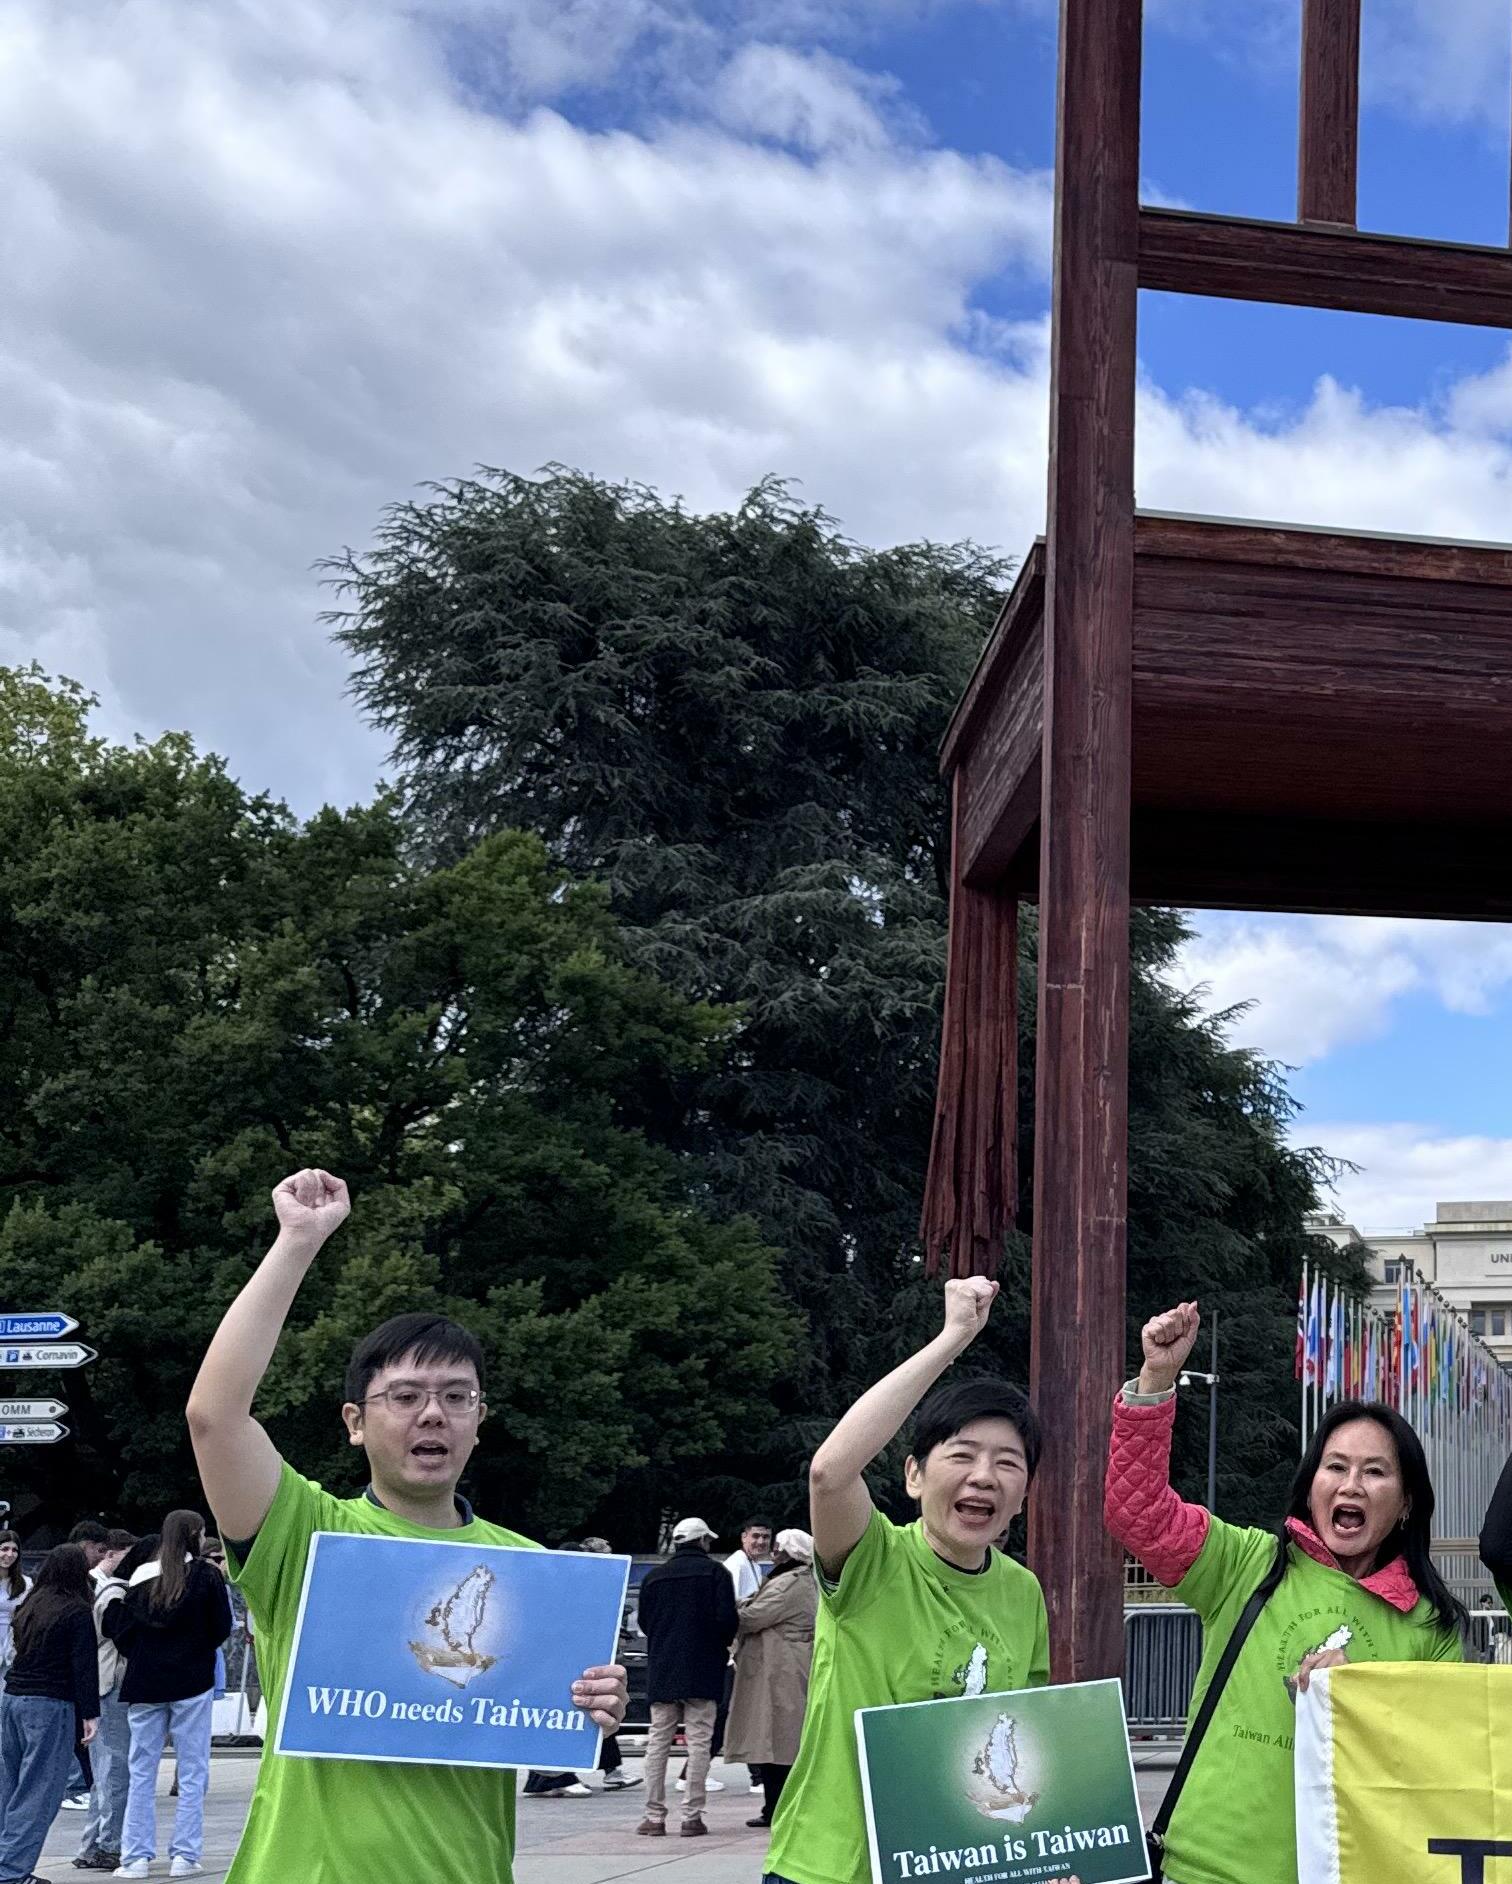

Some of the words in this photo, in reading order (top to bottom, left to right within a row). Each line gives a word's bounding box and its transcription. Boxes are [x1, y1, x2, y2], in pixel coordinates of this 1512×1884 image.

[7, 1320, 61, 1333] Lausanne
[35, 1350, 78, 1360] Cornavin
[2, 1405, 31, 1415] OMM
[1277, 1621, 1298, 1671] HEALTH
[1298, 1608, 1321, 1621] FOR
[1327, 1606, 1348, 1616] ALL
[1352, 1616, 1374, 1648] WITH
[307, 1686, 388, 1718] WHO
[390, 1698, 464, 1724] needs
[470, 1697, 587, 1732] Taiwan
[1233, 1724, 1270, 1744] Taiwan
[893, 1845, 998, 1878] Taiwan
[1003, 1835, 1027, 1862] is
[1031, 1824, 1130, 1857] Taiwan
[1010, 1870, 1023, 1878] ALL
[1024, 1866, 1043, 1875] WITH
